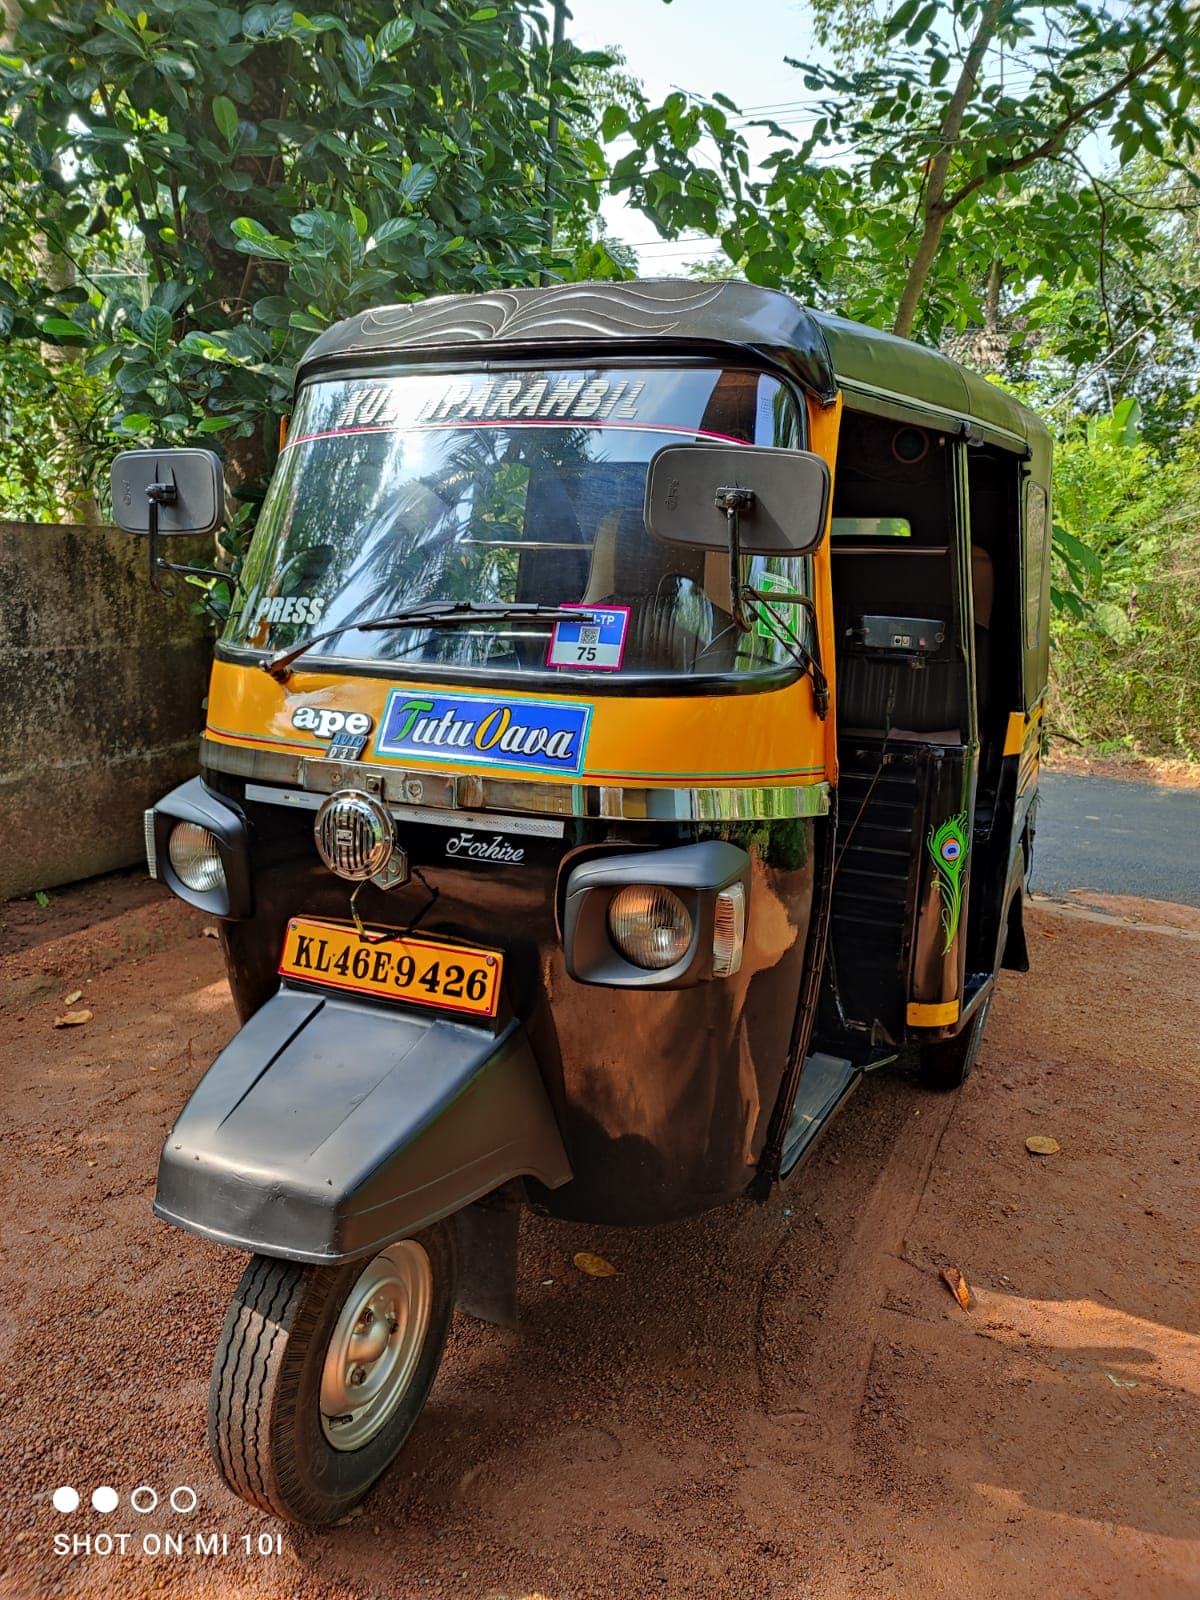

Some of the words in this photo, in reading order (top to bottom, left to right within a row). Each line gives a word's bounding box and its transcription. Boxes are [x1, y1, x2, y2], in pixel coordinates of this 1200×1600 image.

[255, 597, 325, 625] PRESS
[577, 647, 597, 661] 75
[292, 706, 370, 738] ape
[392, 700, 474, 747] Tutu
